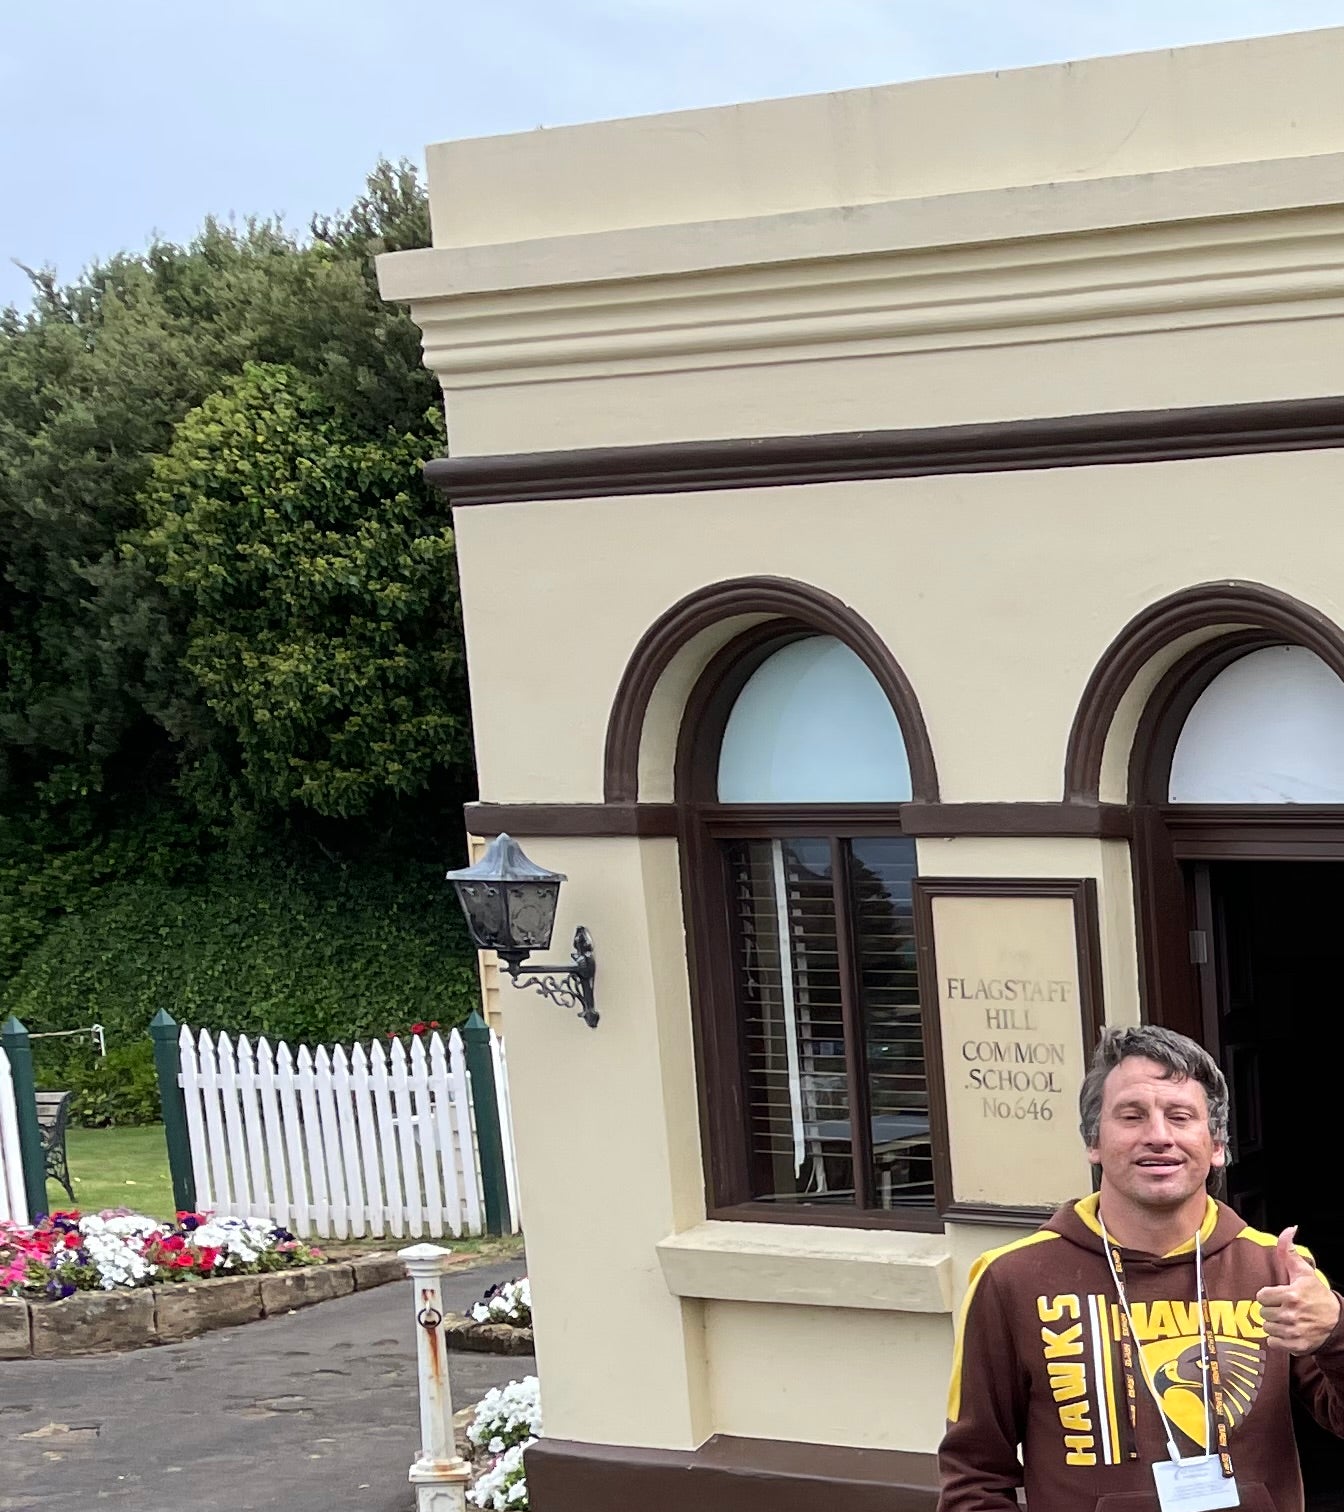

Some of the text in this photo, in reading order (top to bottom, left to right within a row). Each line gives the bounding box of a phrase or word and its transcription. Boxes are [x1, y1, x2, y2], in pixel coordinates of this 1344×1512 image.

[947, 978, 1073, 1002] FLAGSTAFF
[985, 1007, 1037, 1030] HILL
[962, 1040, 1065, 1065] COMMON
[1037, 1294, 1097, 1466] HAWKS
